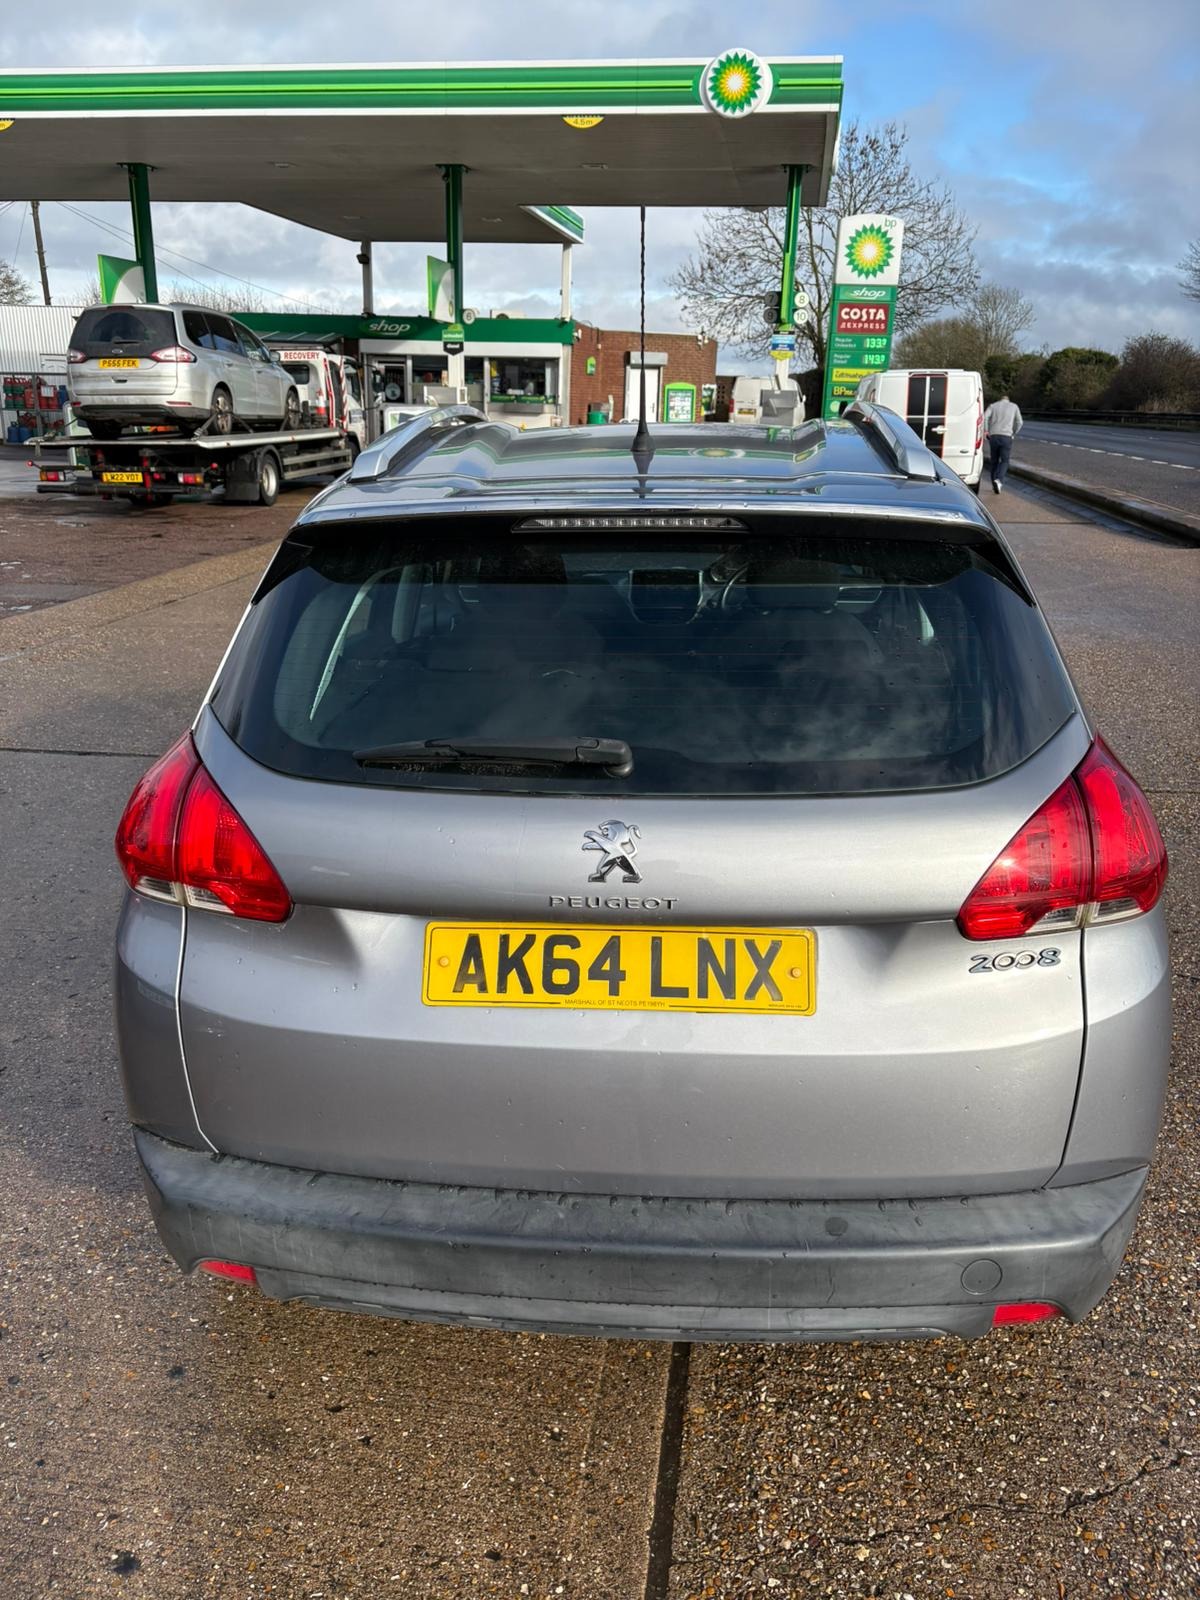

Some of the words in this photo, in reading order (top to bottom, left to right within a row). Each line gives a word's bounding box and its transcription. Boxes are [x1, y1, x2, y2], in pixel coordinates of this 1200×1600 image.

[884, 217, 898, 228] bp
[852, 286, 887, 300] shop
[840, 306, 886, 322] COSTA
[369, 319, 411, 336] shop
[846, 321, 886, 330] EXPRESS
[283, 351, 320, 360] RECOVERY
[548, 895, 680, 911] PEUGEOT
[452, 932, 627, 997] AK64
[650, 935, 784, 1002] LNX
[968, 946, 1062, 974] 2008
